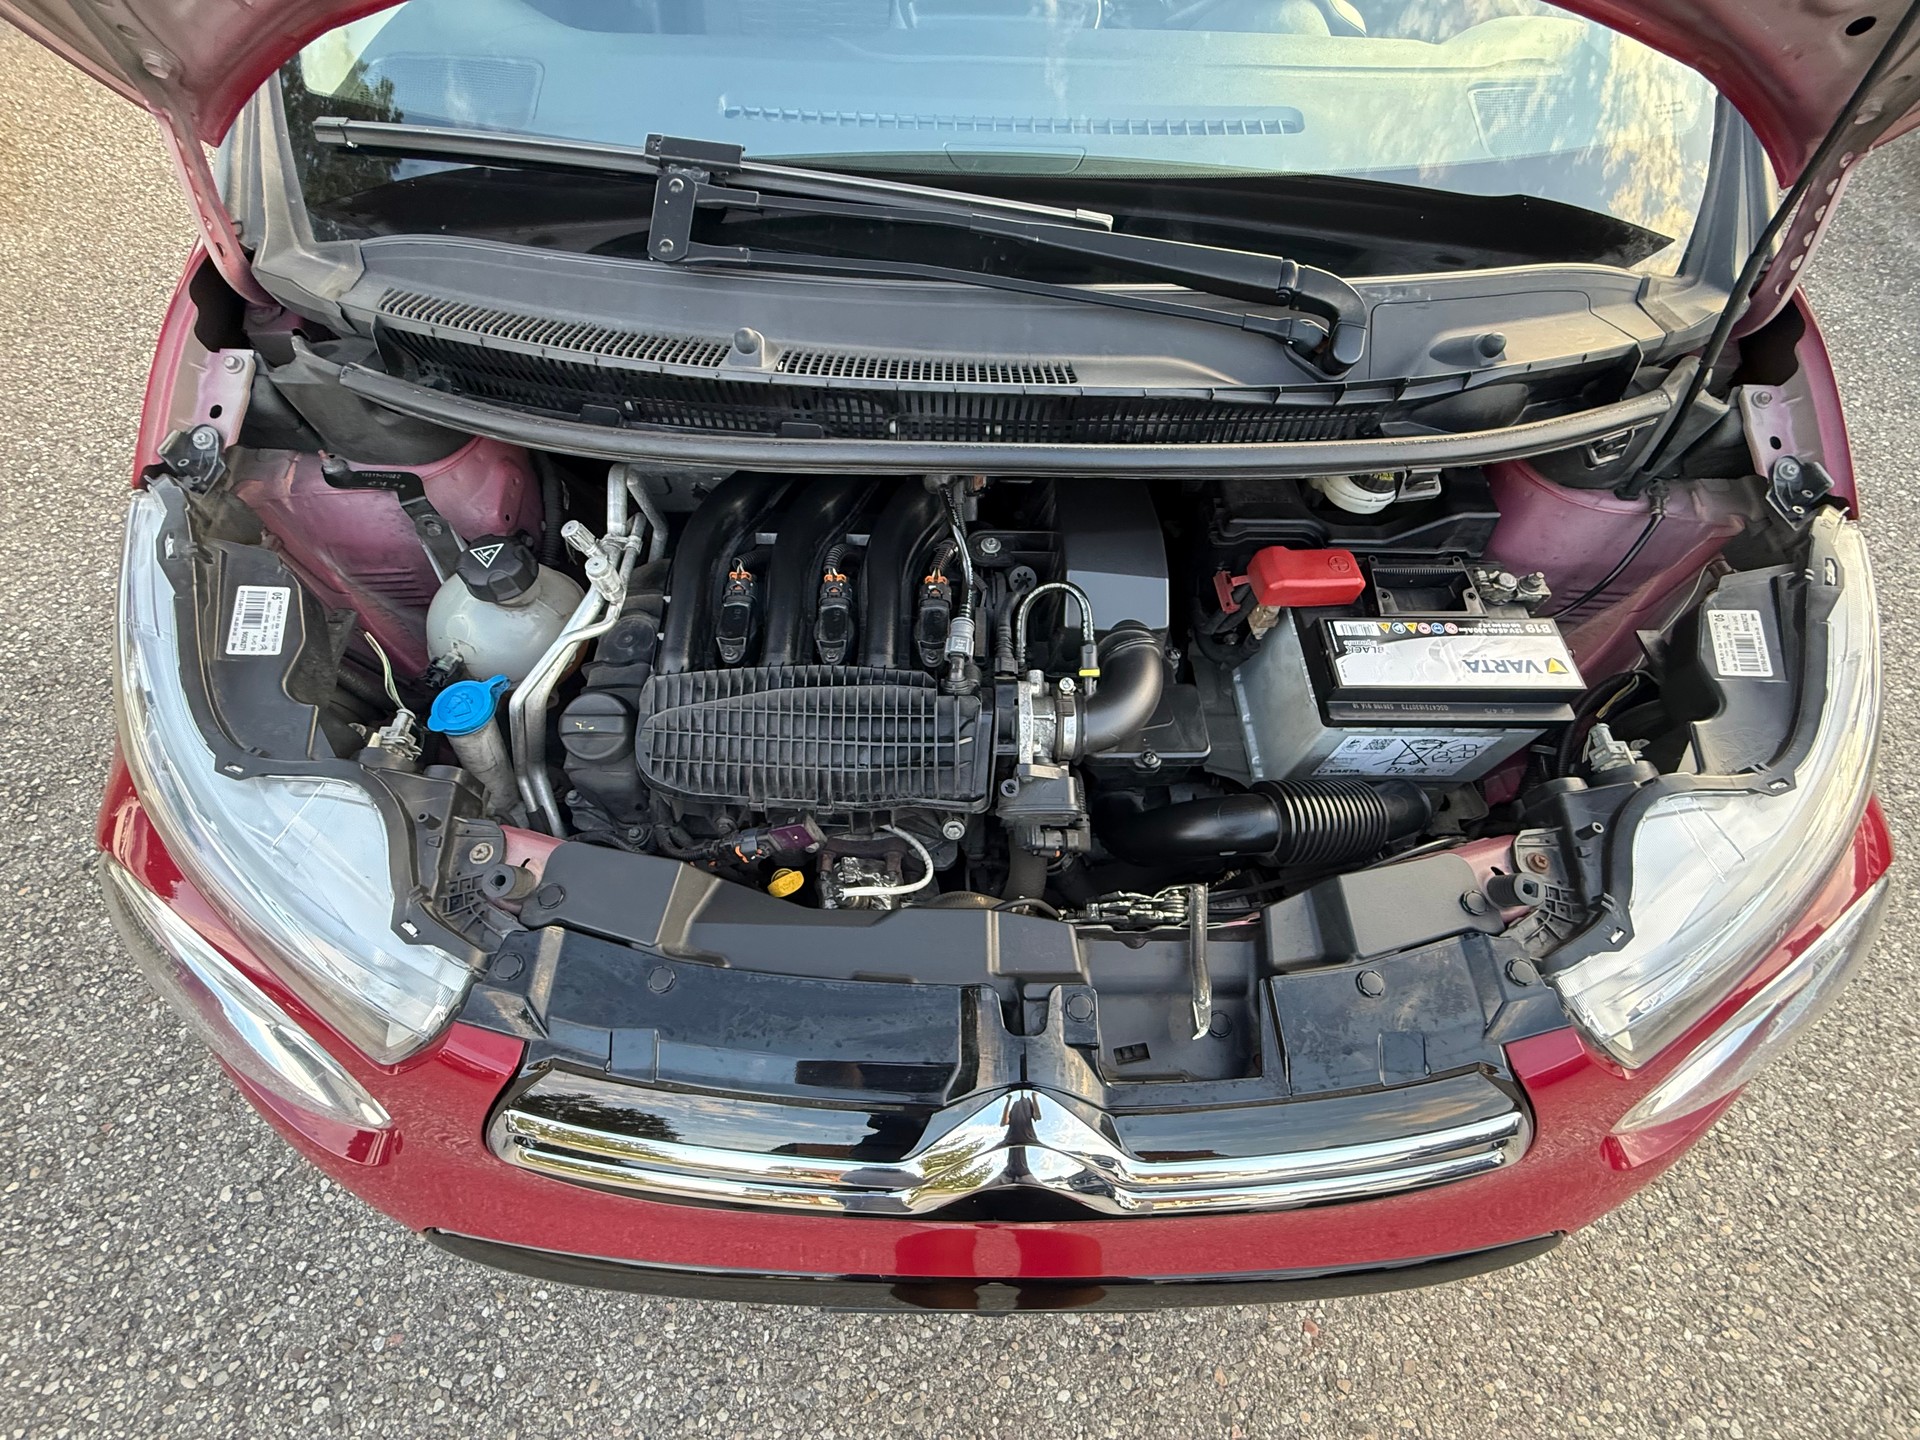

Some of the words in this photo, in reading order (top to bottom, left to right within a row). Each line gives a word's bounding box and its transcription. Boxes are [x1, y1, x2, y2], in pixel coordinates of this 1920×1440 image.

[271, 591, 283, 600] 05
[1713, 613, 1725, 622] 05
[1525, 624, 1552, 634] B19
[1461, 660, 1544, 673] VARTA
